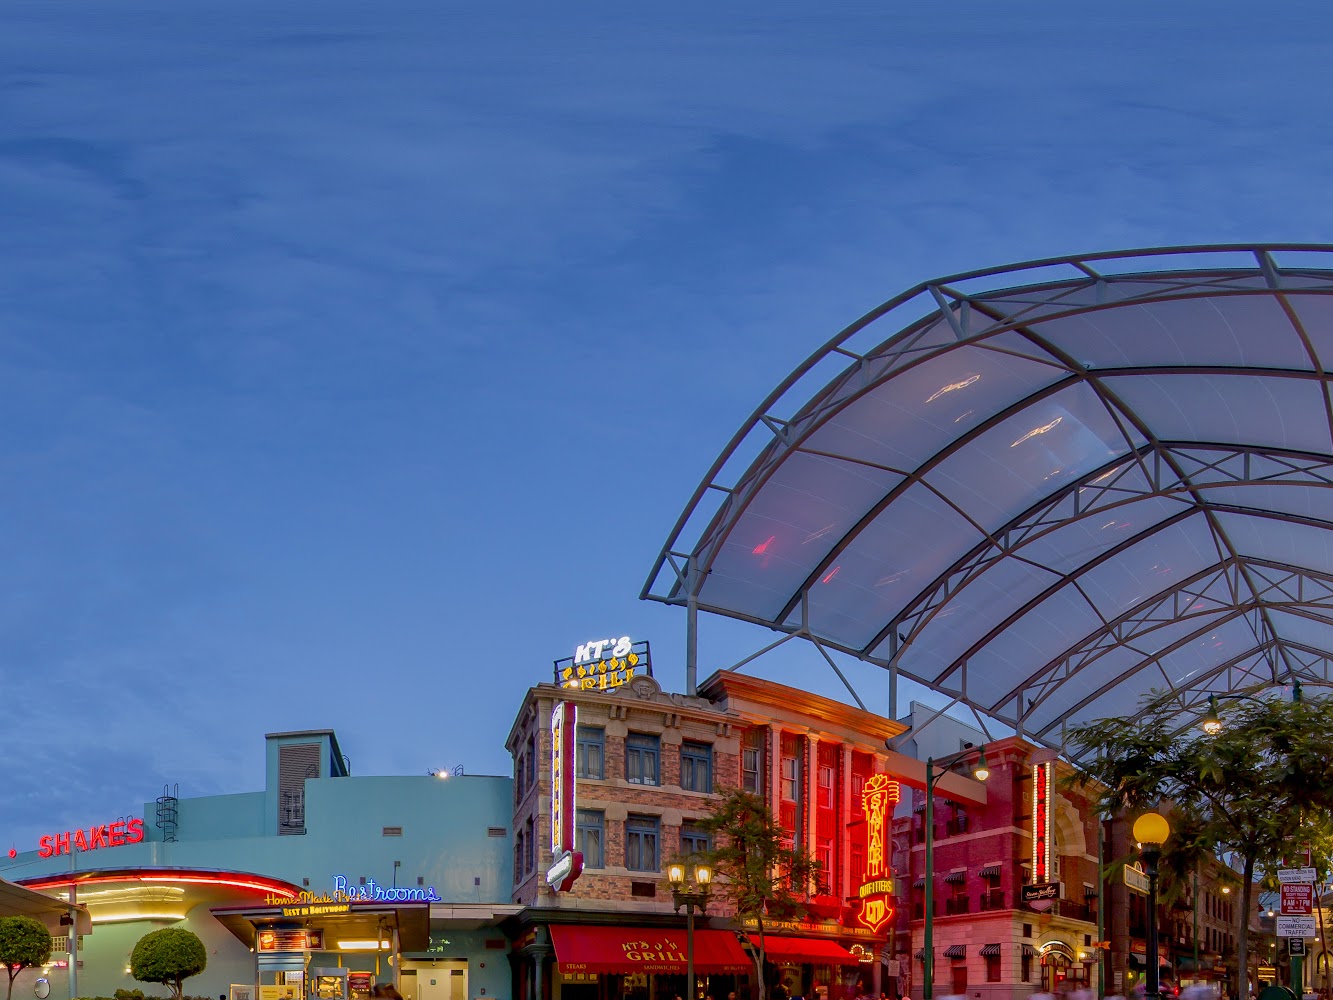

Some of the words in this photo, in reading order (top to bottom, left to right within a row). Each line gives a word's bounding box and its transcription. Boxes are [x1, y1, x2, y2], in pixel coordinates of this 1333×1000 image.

[574, 636, 632, 663] KT'S
[38, 818, 145, 859] SHAKES
[869, 792, 882, 877] SAFARI
[333, 874, 442, 902] Restrooms
[859, 880, 893, 898] OUTFITTERS
[1290, 885, 1310, 893] STANDING
[283, 907, 301, 917] BEST
[301, 907, 309, 916] IN
[866, 900, 885, 924] LTD
[1287, 899, 1295, 907] AM
[1303, 899, 1311, 907] PM
[622, 940, 650, 952] KT'S
[625, 951, 689, 962] GRILL
